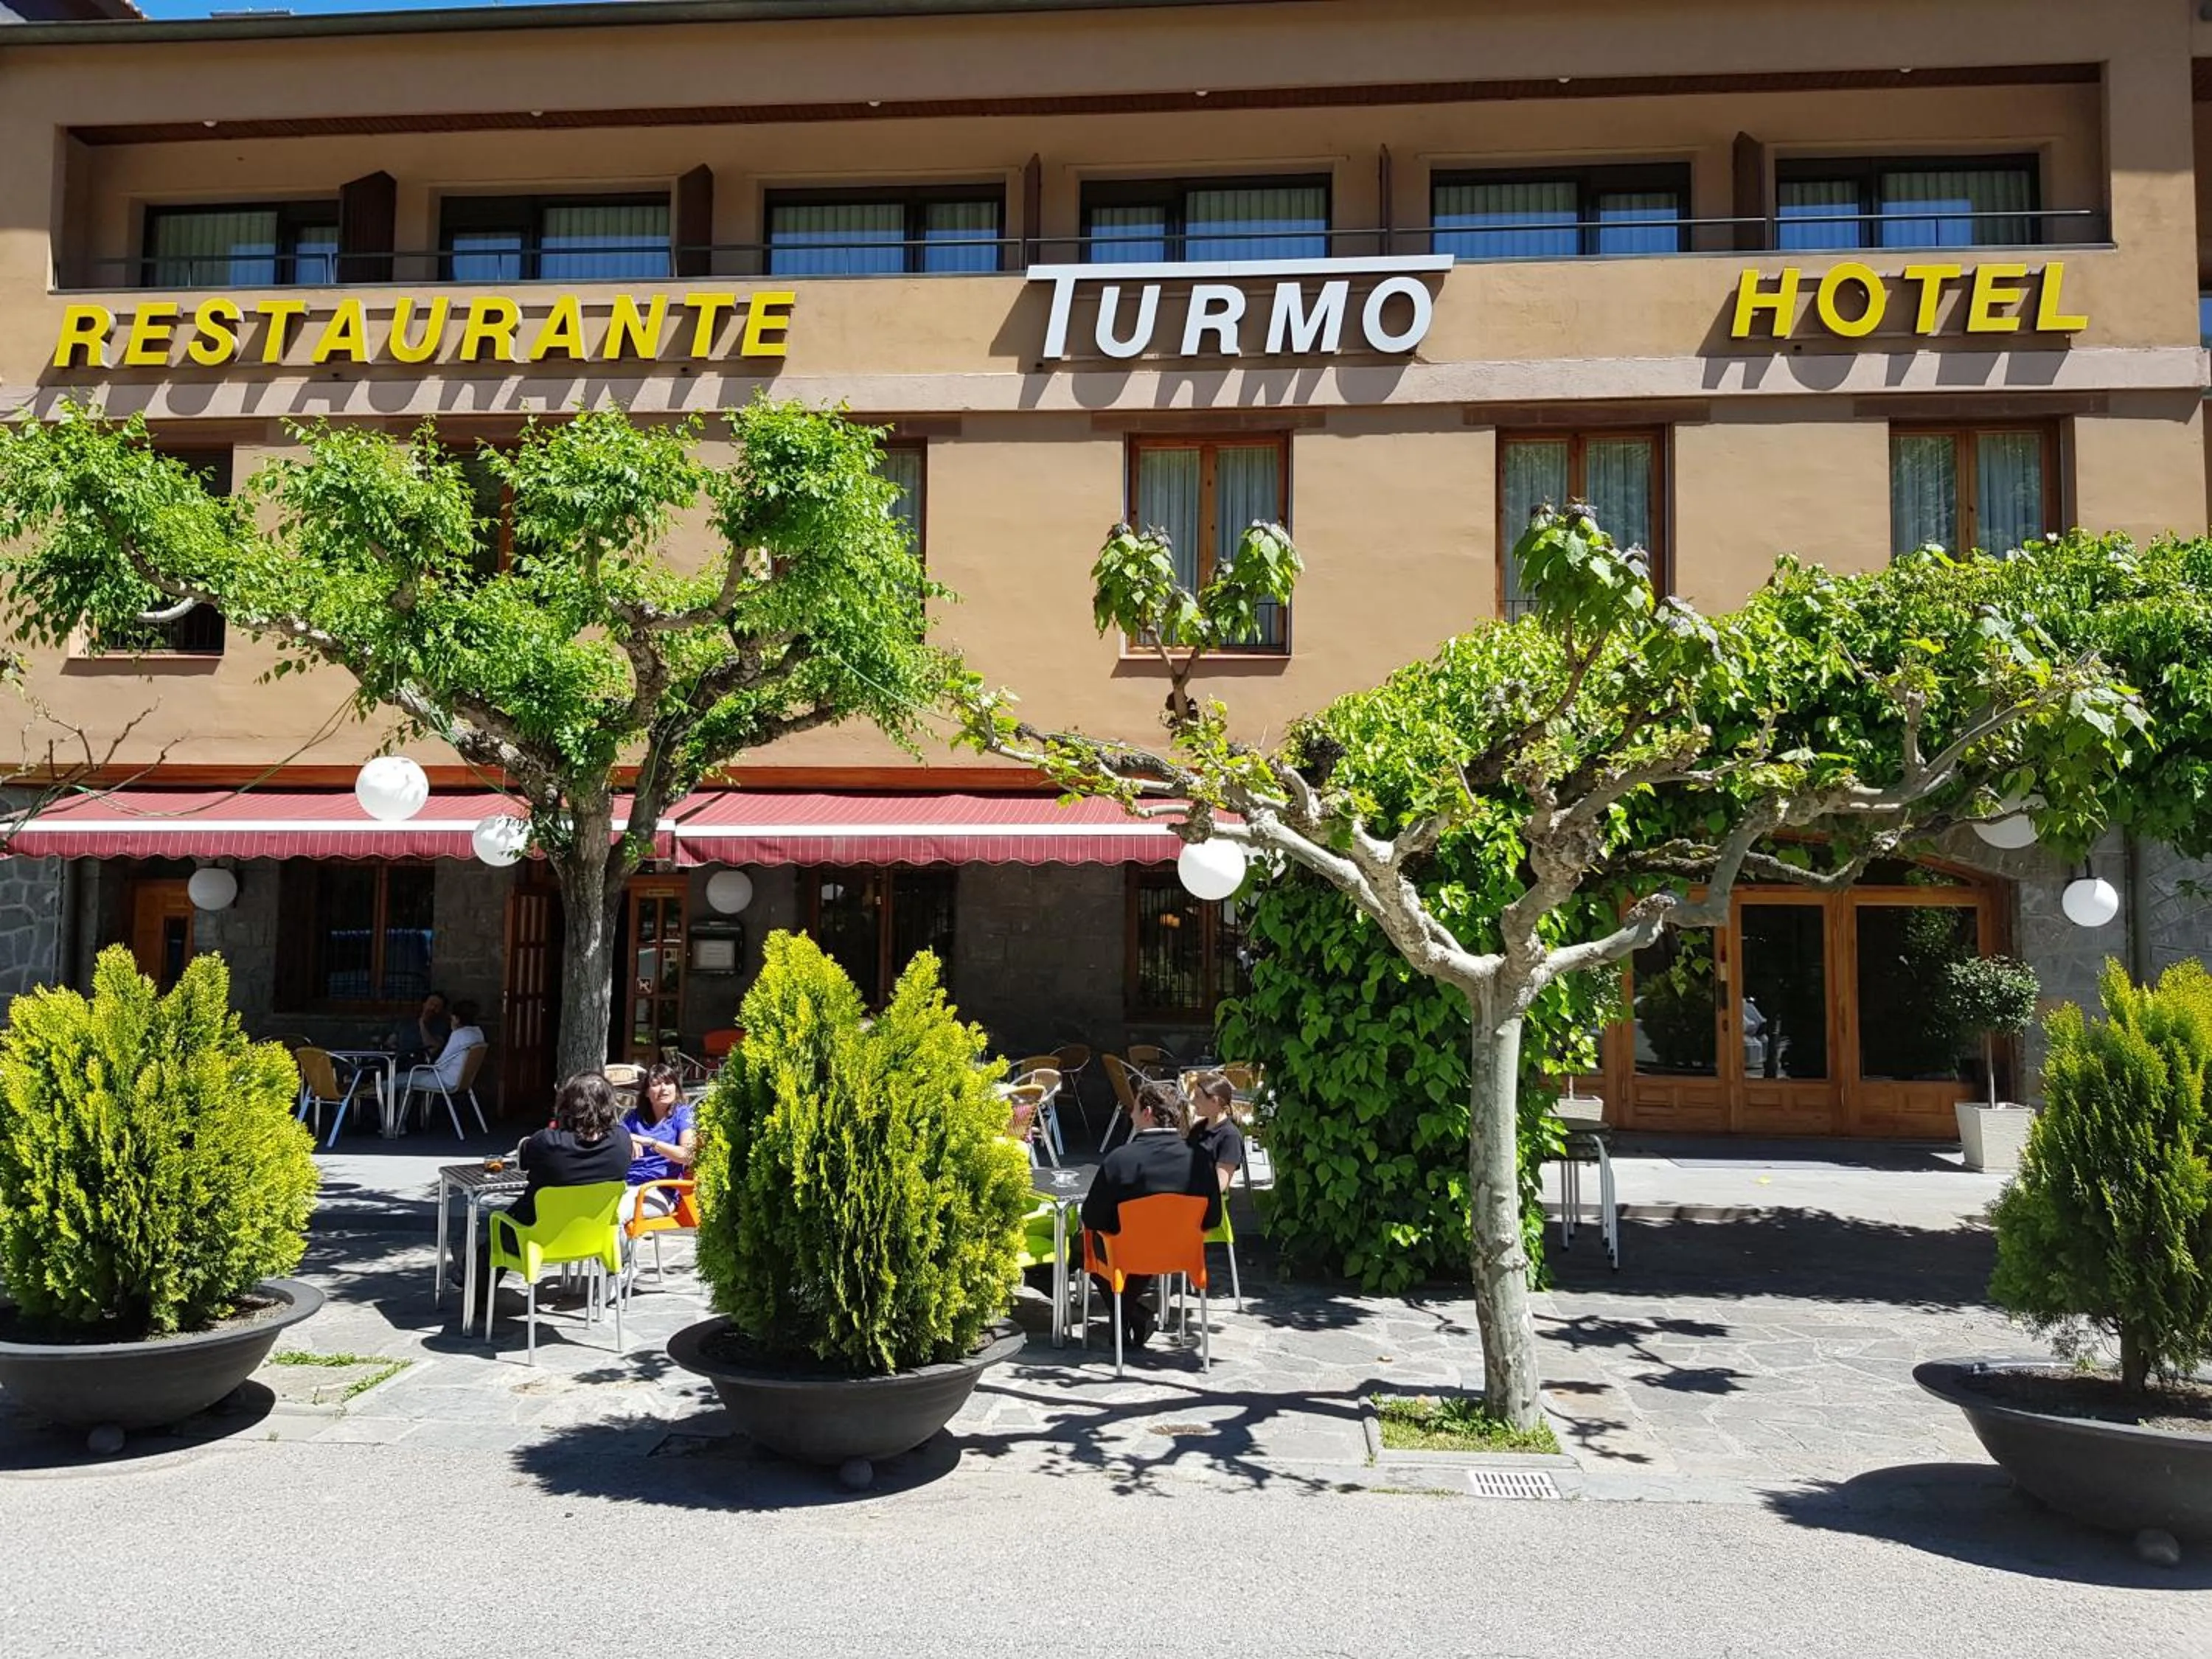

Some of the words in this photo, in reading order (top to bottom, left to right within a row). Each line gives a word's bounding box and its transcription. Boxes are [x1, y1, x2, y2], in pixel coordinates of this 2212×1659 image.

[53, 291, 797, 367] RESTAURANTE
[1026, 254, 1455, 359] TURMO
[1731, 262, 2089, 338] HOTEL
